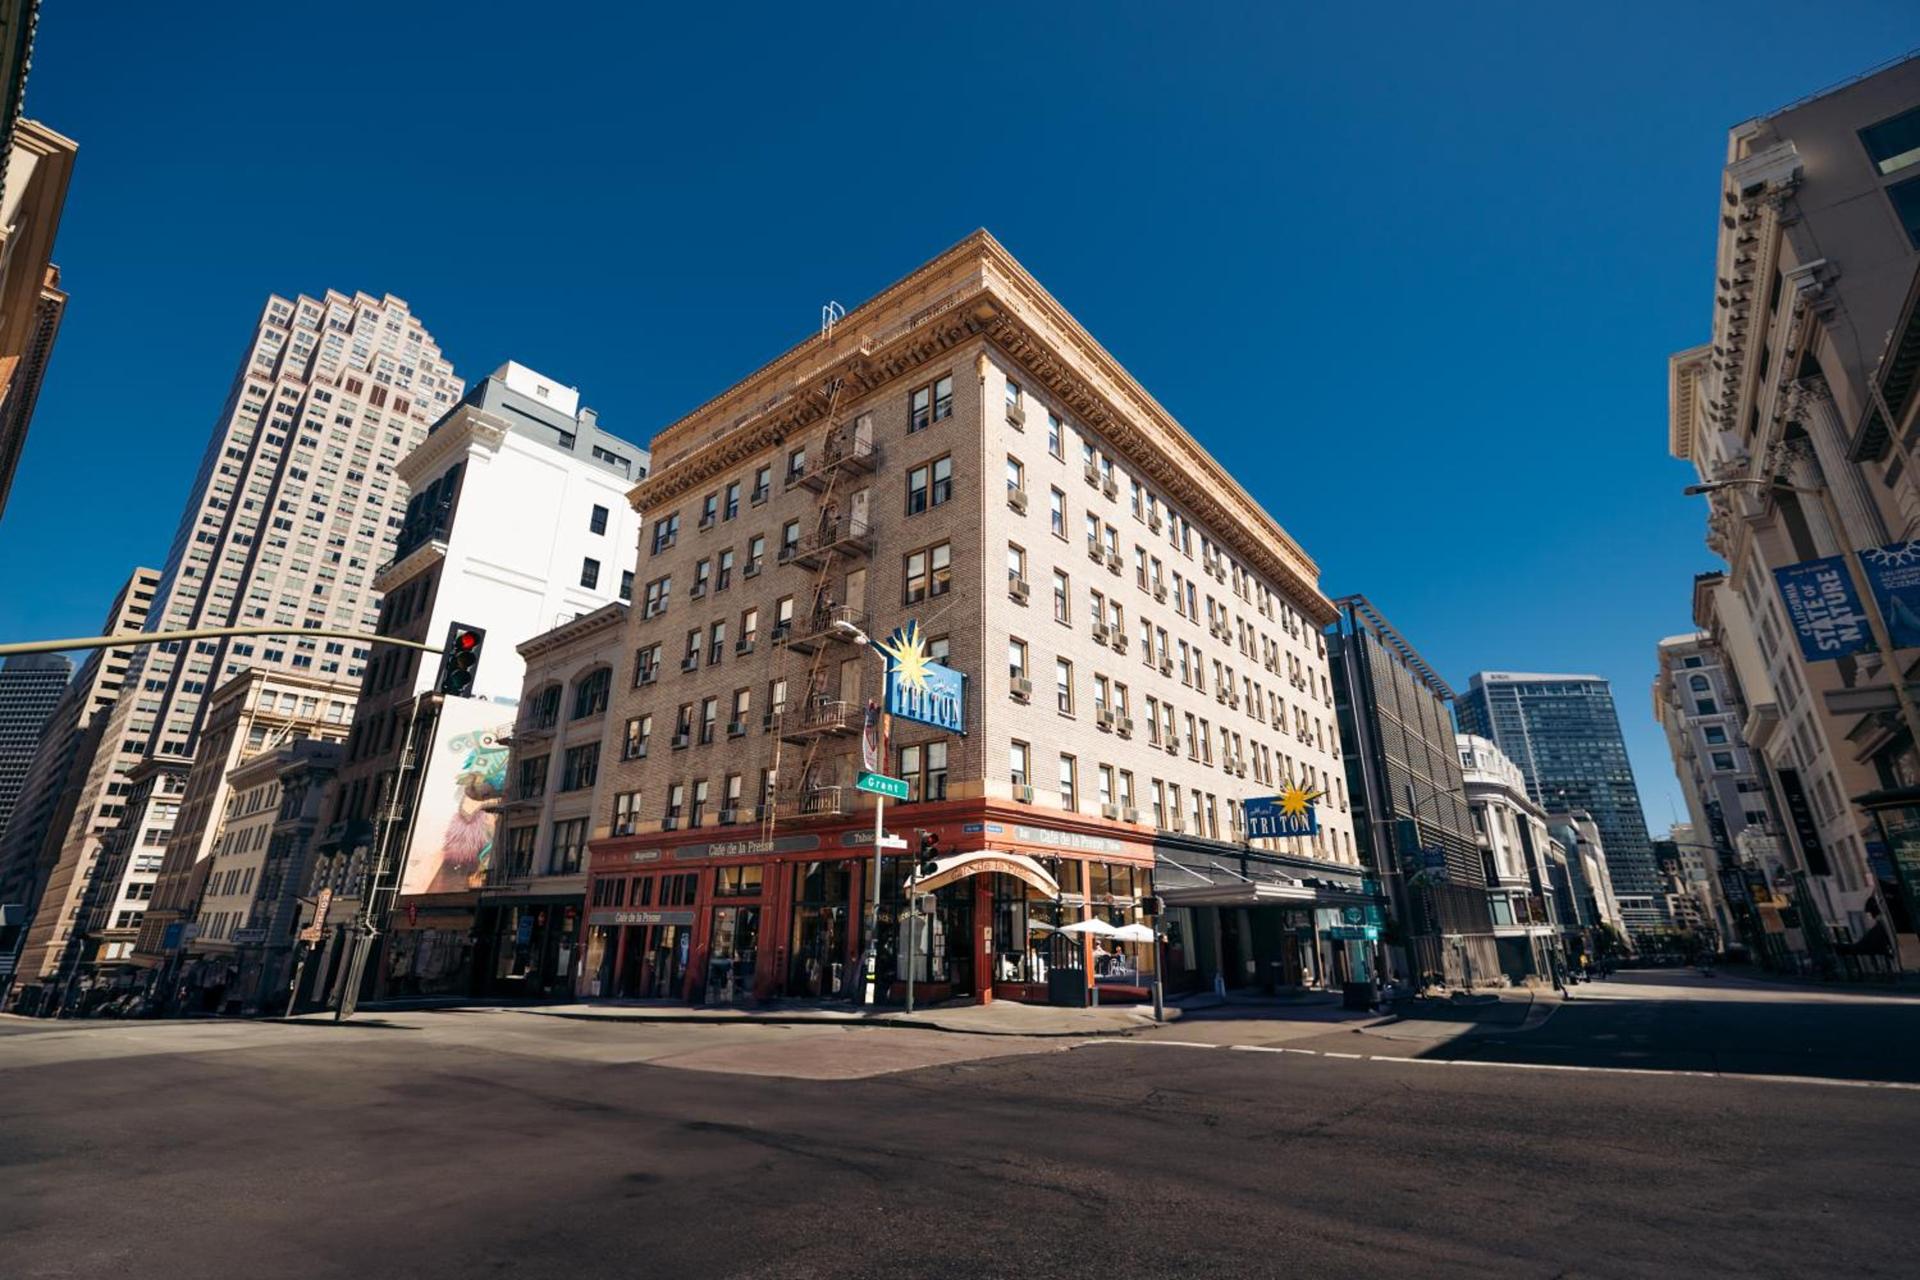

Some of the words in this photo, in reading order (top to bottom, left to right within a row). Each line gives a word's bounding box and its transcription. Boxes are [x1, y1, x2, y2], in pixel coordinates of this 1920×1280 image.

[1801, 584, 1817, 597] OF
[1784, 582, 1813, 637] CALIFORNIA
[1816, 569, 1863, 643] NATURE
[1803, 597, 1841, 651] STATE
[867, 777, 899, 793] Grant
[1250, 814, 1311, 835] TRITON
[727, 842, 737, 856] de
[738, 841, 746, 854] la
